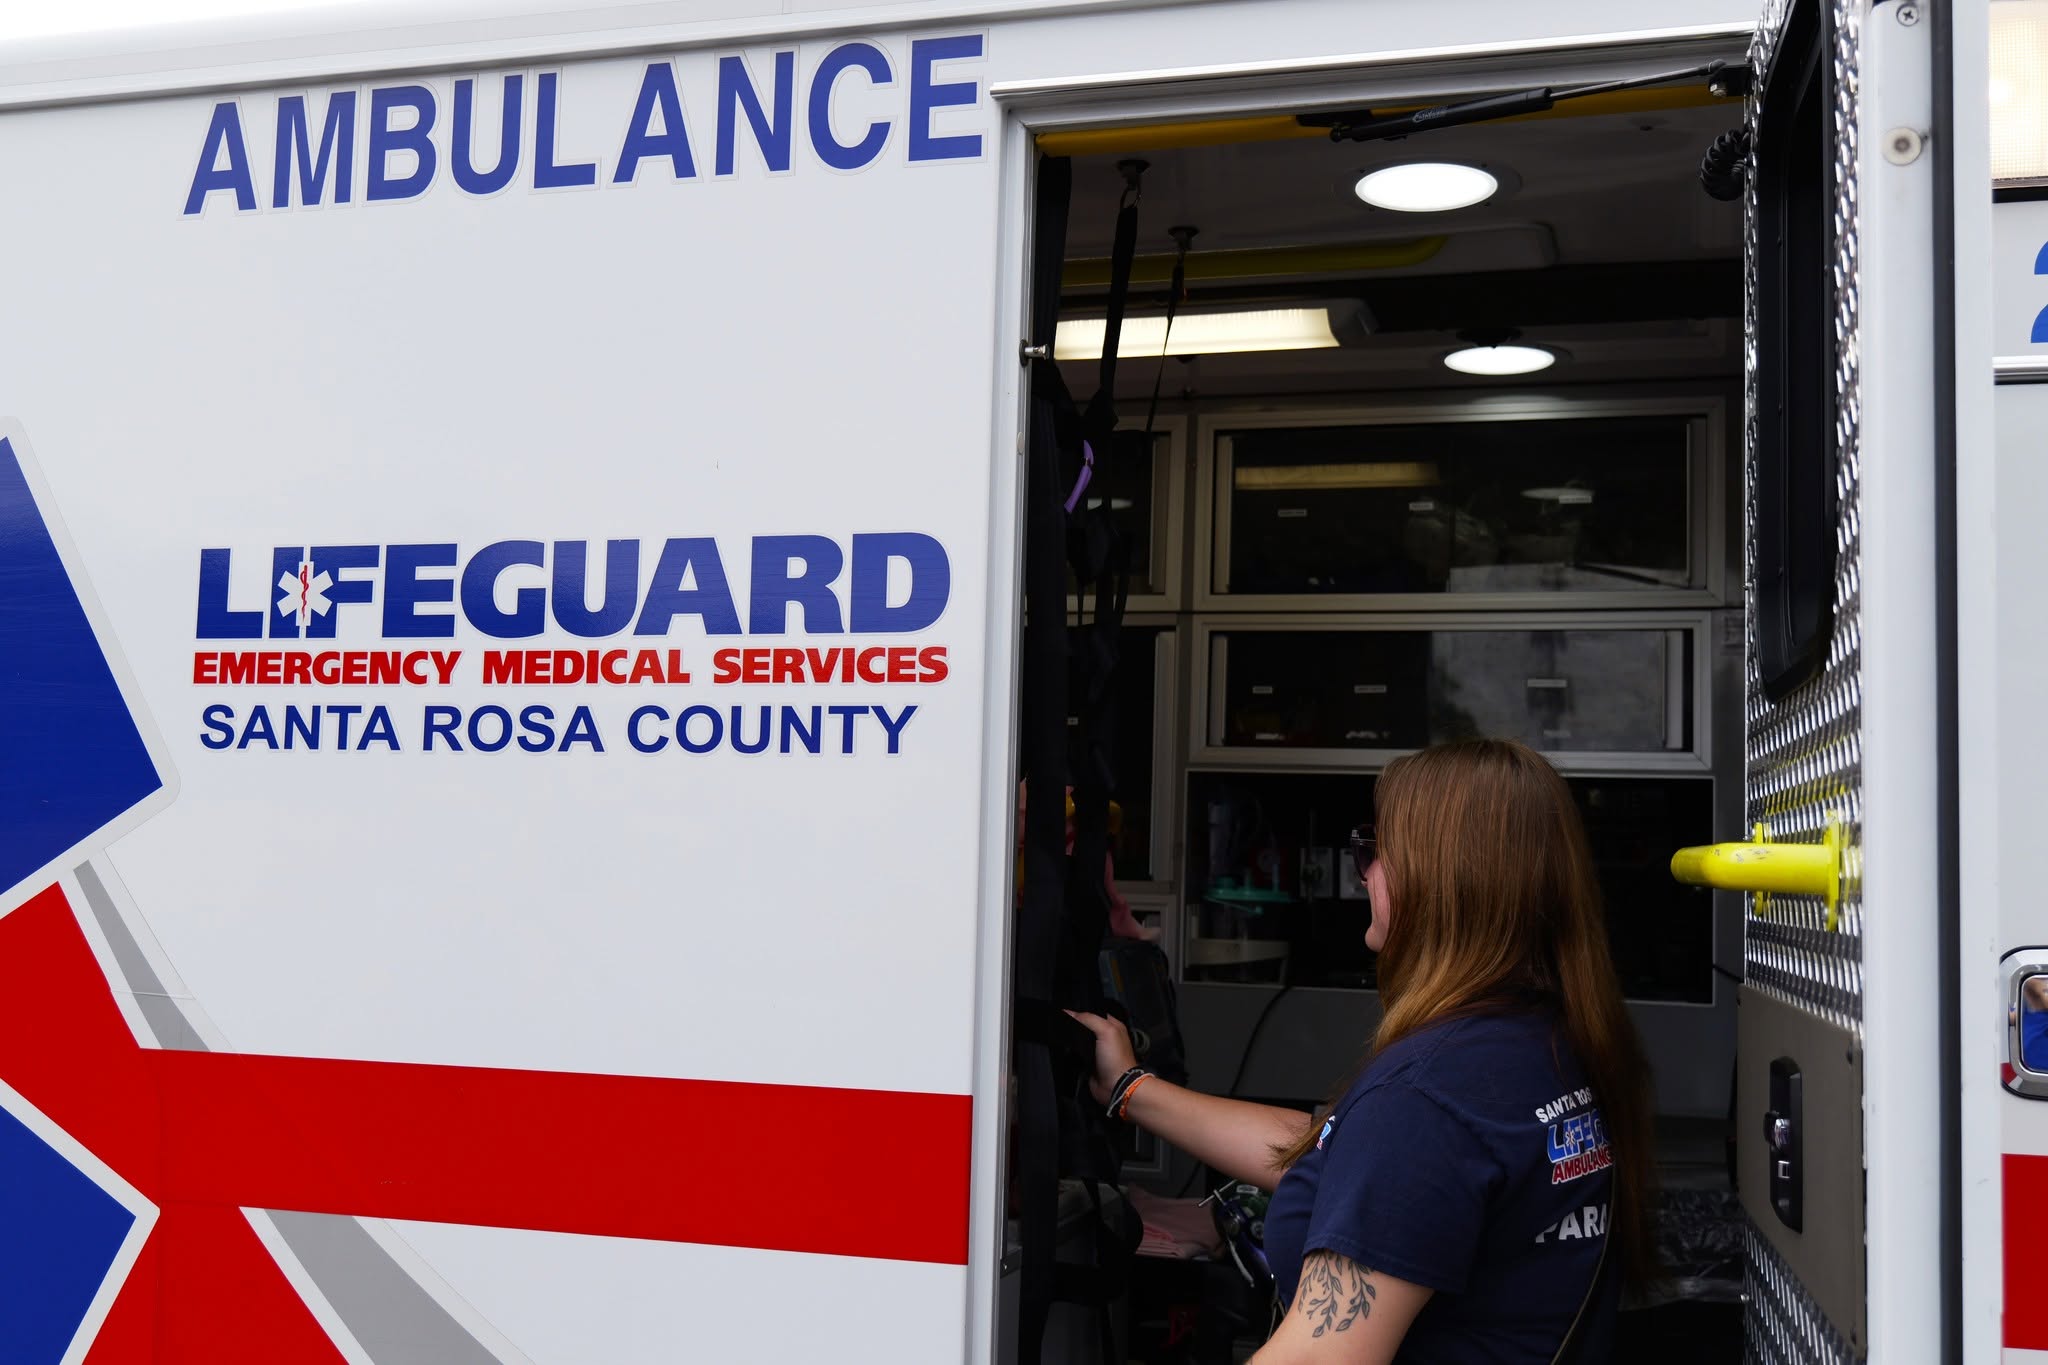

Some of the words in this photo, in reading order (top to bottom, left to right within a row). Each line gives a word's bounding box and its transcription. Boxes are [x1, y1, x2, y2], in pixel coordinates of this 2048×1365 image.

[184, 35, 984, 215] AMBULANCE
[195, 532, 951, 640] LIFEGUARD
[193, 650, 461, 685] EMERGENCY
[482, 649, 690, 685] MEDICAL
[713, 646, 949, 684] SERVICES
[199, 704, 401, 751] SANTA
[423, 704, 605, 753] ROSA
[627, 704, 918, 754] COUNTY
[1535, 1092, 1577, 1124] SANTA
[1574, 1086, 1593, 1107] ROS
[1547, 1108, 1607, 1164] LIFEG
[1552, 1143, 1615, 1185] AMBULANC
